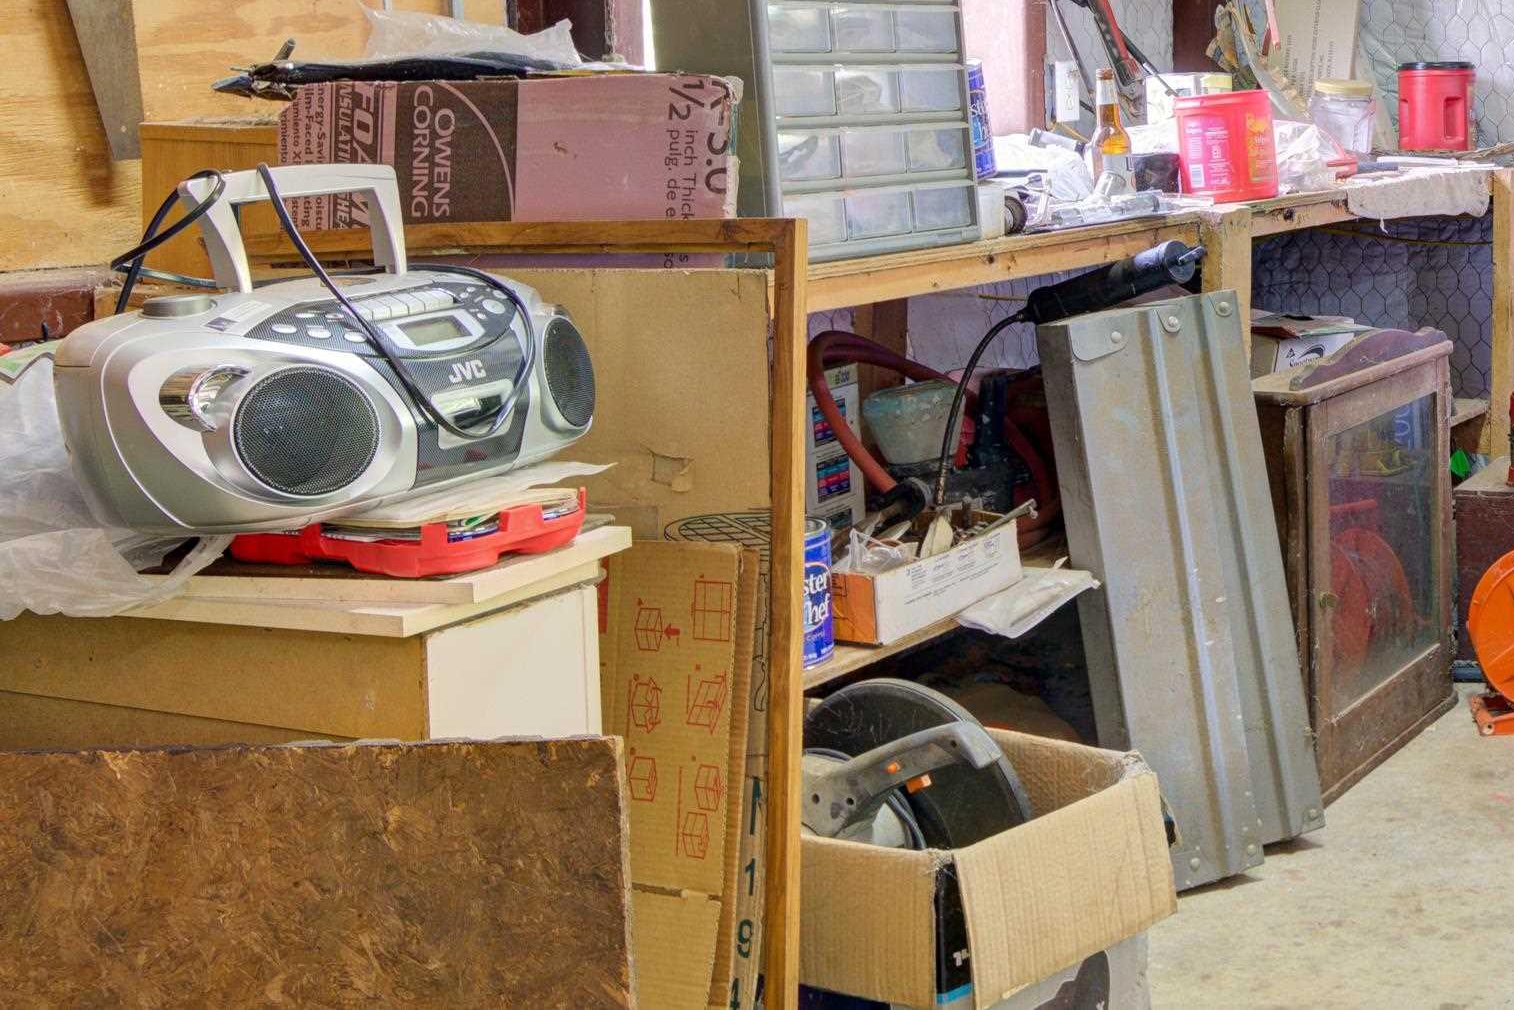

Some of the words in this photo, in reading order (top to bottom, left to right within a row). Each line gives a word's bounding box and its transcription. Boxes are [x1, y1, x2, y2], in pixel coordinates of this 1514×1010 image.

[303, 85, 314, 155] ilm-Faced
[668, 79, 705, 121] 1/2
[316, 83, 327, 163] nergy-Savi
[336, 85, 353, 163] NSULATI
[411, 85, 434, 218] CORNING
[432, 108, 456, 218] OWENS
[664, 129, 683, 171] pulg.
[684, 129, 698, 166] inch
[666, 178, 681, 201] de
[448, 359, 487, 384] JVC
[804, 570, 829, 597] ster
[804, 593, 831, 625] hef
